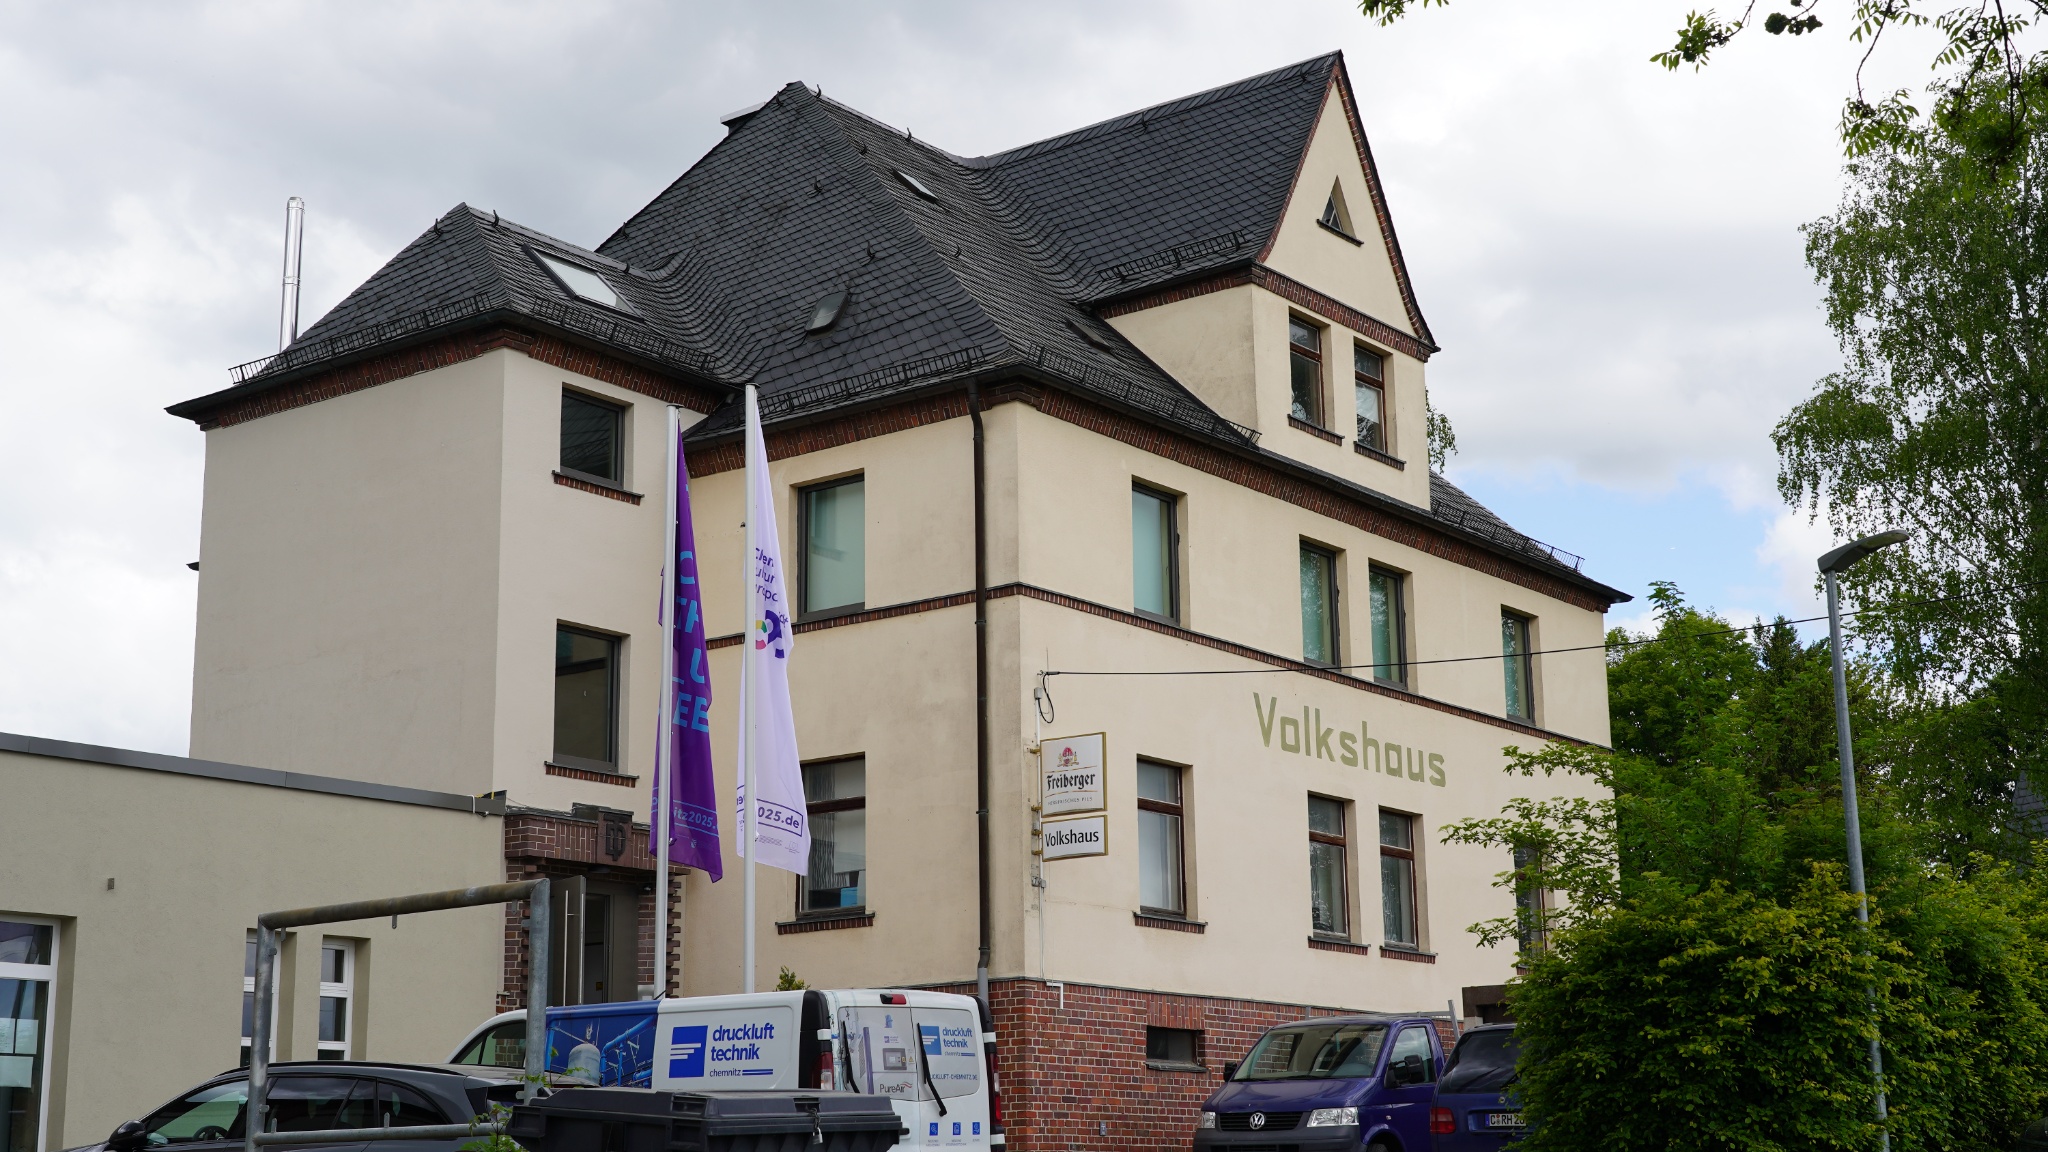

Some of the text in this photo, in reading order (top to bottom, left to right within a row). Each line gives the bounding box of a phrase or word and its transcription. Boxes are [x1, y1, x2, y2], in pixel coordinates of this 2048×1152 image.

[1253, 692, 1446, 787] Volkshaus
[1046, 773, 1096, 791] Freiberger
[673, 806, 718, 829] itz2025.
[758, 806, 800, 829] 025.de
[1045, 829, 1099, 847] Volkshaus
[712, 1023, 774, 1042] druckluft
[942, 1027, 973, 1038] druckluft
[943, 1038, 969, 1048] technik
[711, 1043, 760, 1062] technik
[709, 1068, 741, 1078] chemnitz
[880, 1083, 906, 1094] PureAir
[1490, 1114, 1496, 1125] C
[1501, 1114, 1513, 1125] RH
